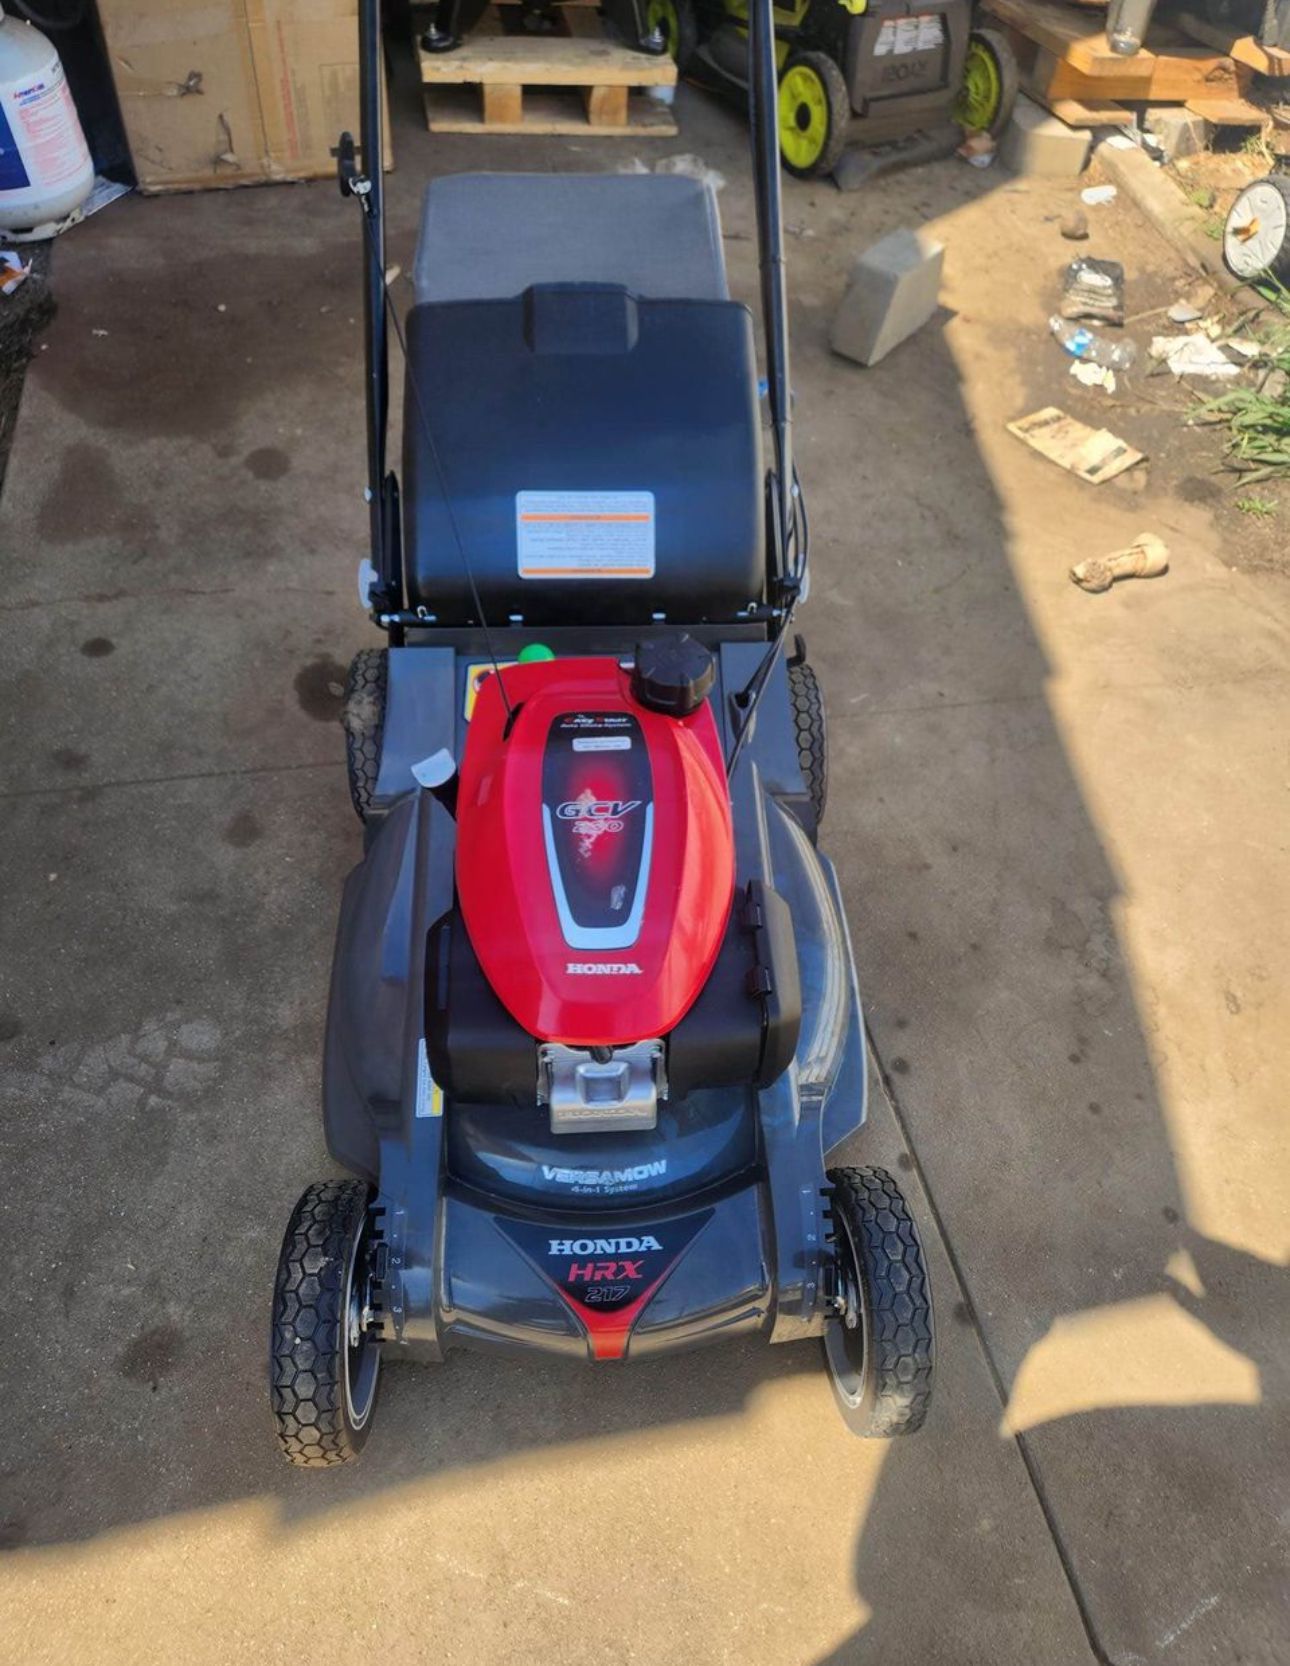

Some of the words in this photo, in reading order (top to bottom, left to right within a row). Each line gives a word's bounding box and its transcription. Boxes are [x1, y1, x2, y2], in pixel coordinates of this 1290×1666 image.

[556, 800, 642, 819] GCV
[566, 963, 644, 975] HONDA
[542, 1159, 667, 1185] VERSAMOW
[548, 1235, 663, 1255] HONDA
[568, 1260, 645, 1282] HRX
[584, 1285, 630, 1303] 217
